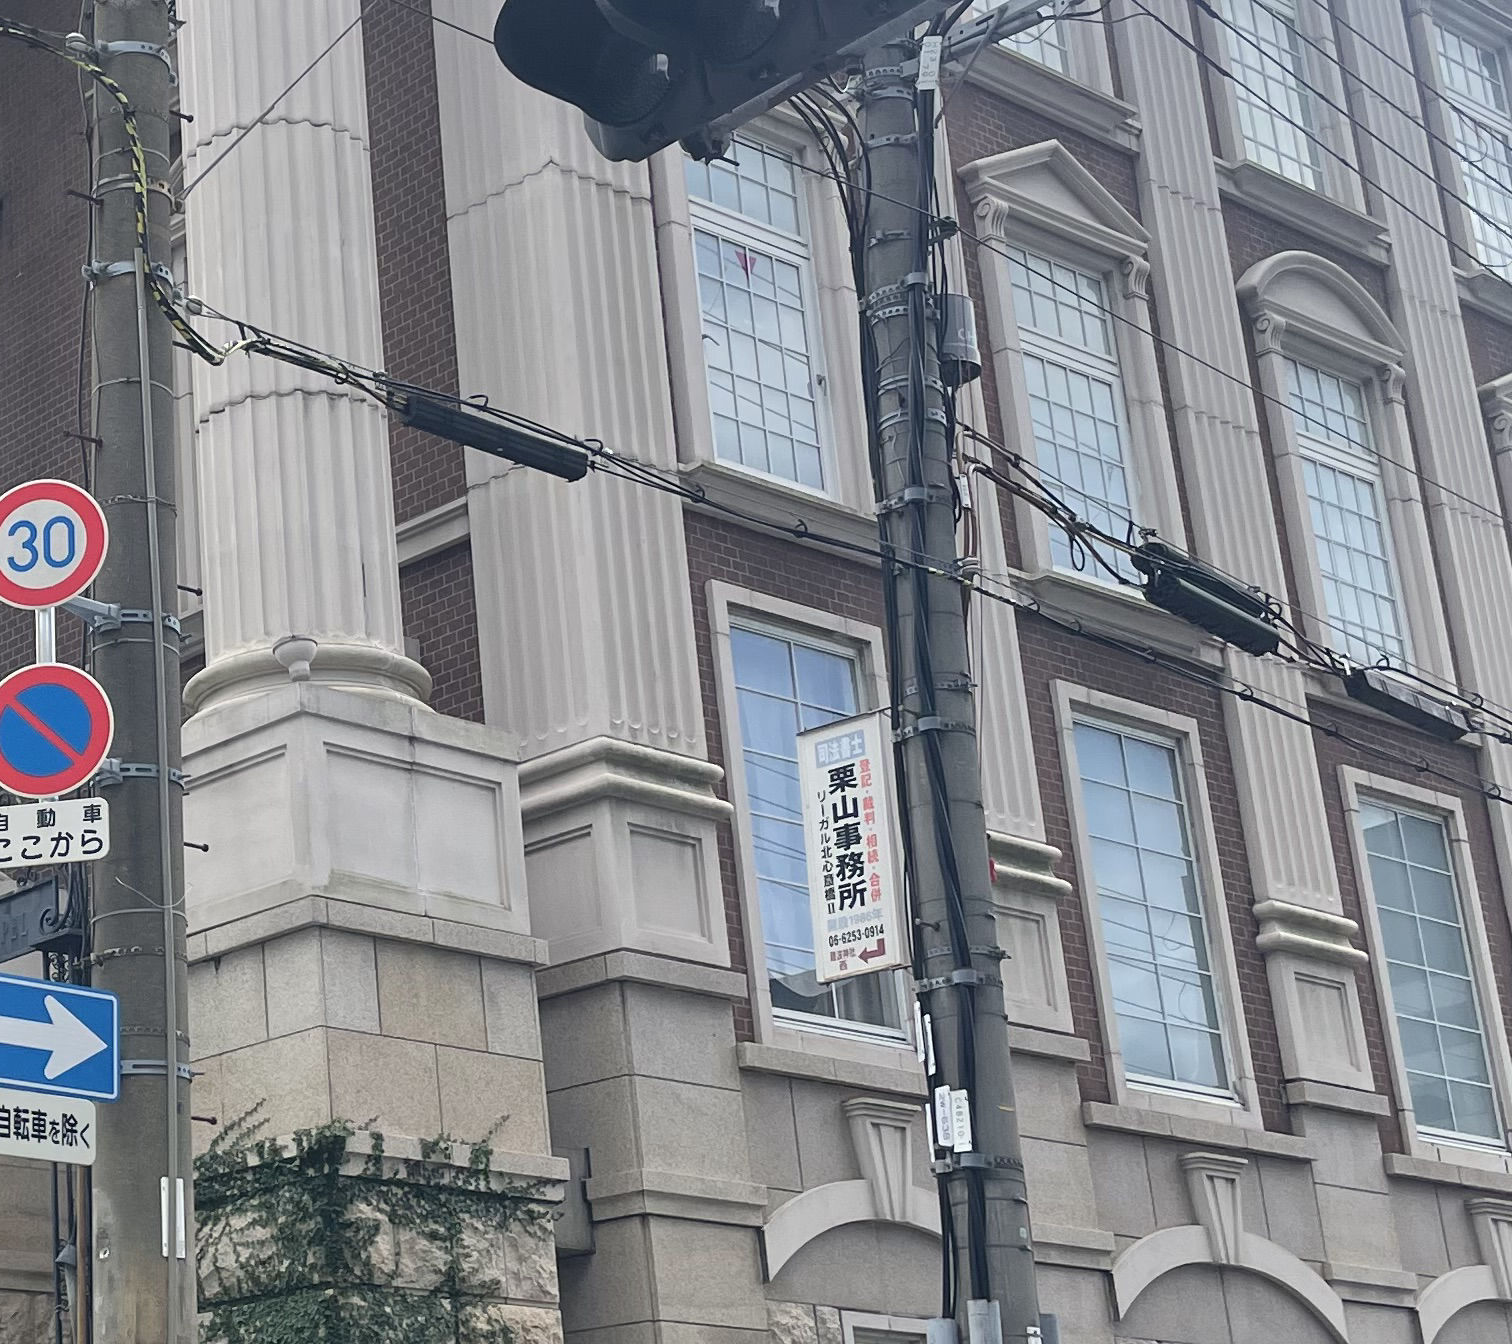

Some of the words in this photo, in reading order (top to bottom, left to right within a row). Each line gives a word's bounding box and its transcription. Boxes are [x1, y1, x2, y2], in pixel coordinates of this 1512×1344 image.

[7, 515, 76, 573] 30
[816, 732, 865, 764] 司法書士
[827, 762, 868, 912] 栗山事務所
[828, 923, 885, 948] 06-6253-0914
